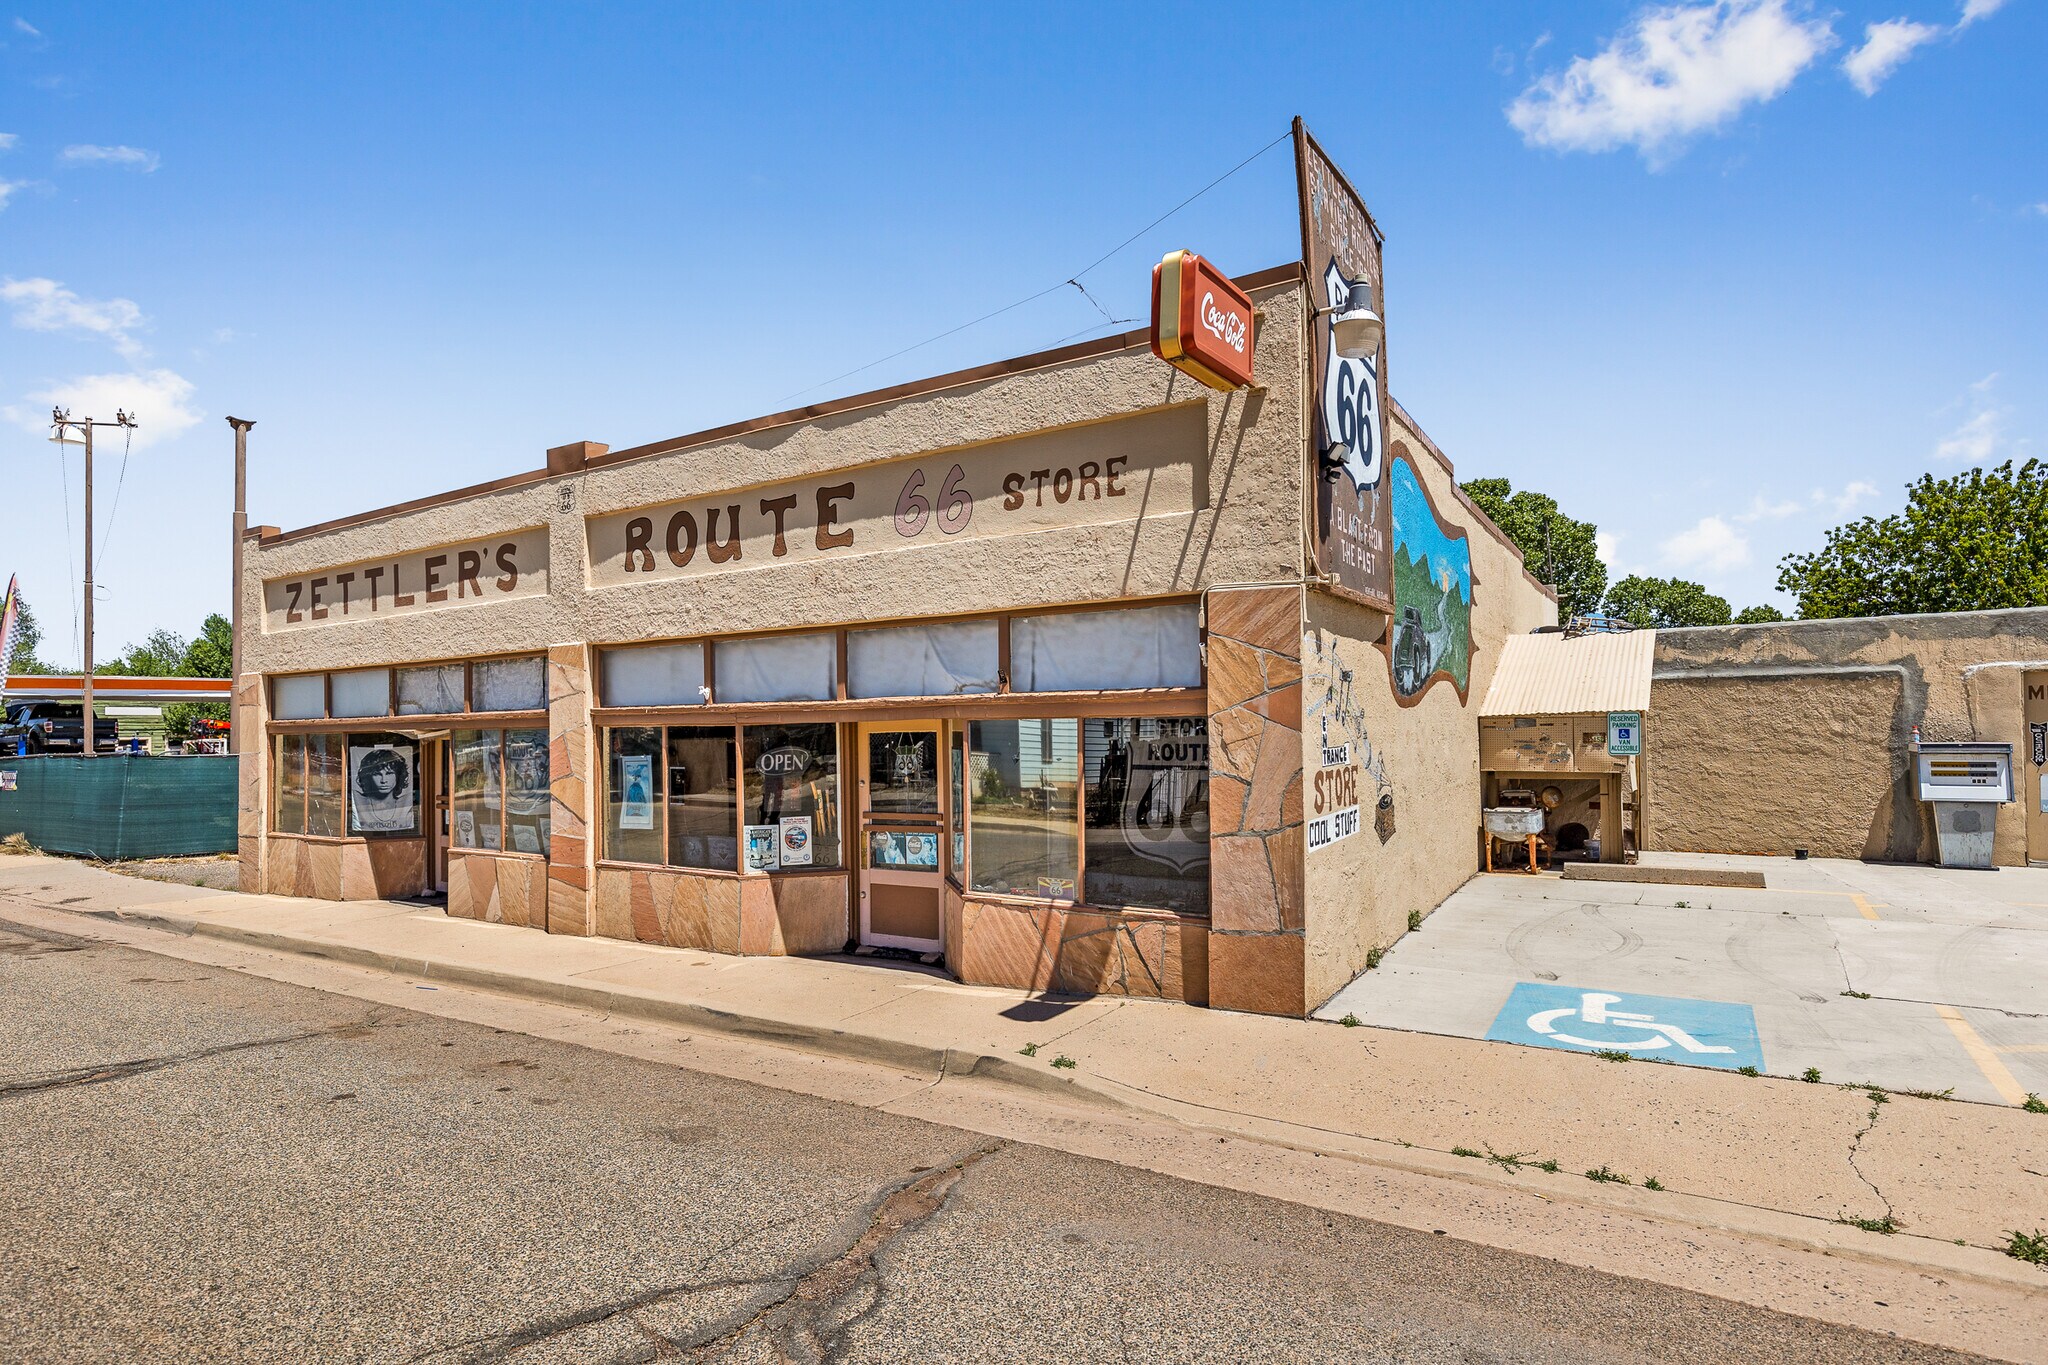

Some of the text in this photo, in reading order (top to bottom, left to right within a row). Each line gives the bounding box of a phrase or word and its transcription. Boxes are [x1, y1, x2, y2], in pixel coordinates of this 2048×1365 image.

[1337, 360, 1371, 467] 66
[625, 455, 1128, 573] ROUTE 66 STORE
[1340, 539, 1375, 576] THE PAST
[286, 542, 518, 624] ZETTLER'S
[761, 754, 803, 770] OPEN
[2034, 733, 2044, 763] OUTHOUSE
[1314, 765, 1358, 814] STORE
[1309, 809, 1358, 848] COOL STUFF
[1051, 886, 1061, 894] 66
